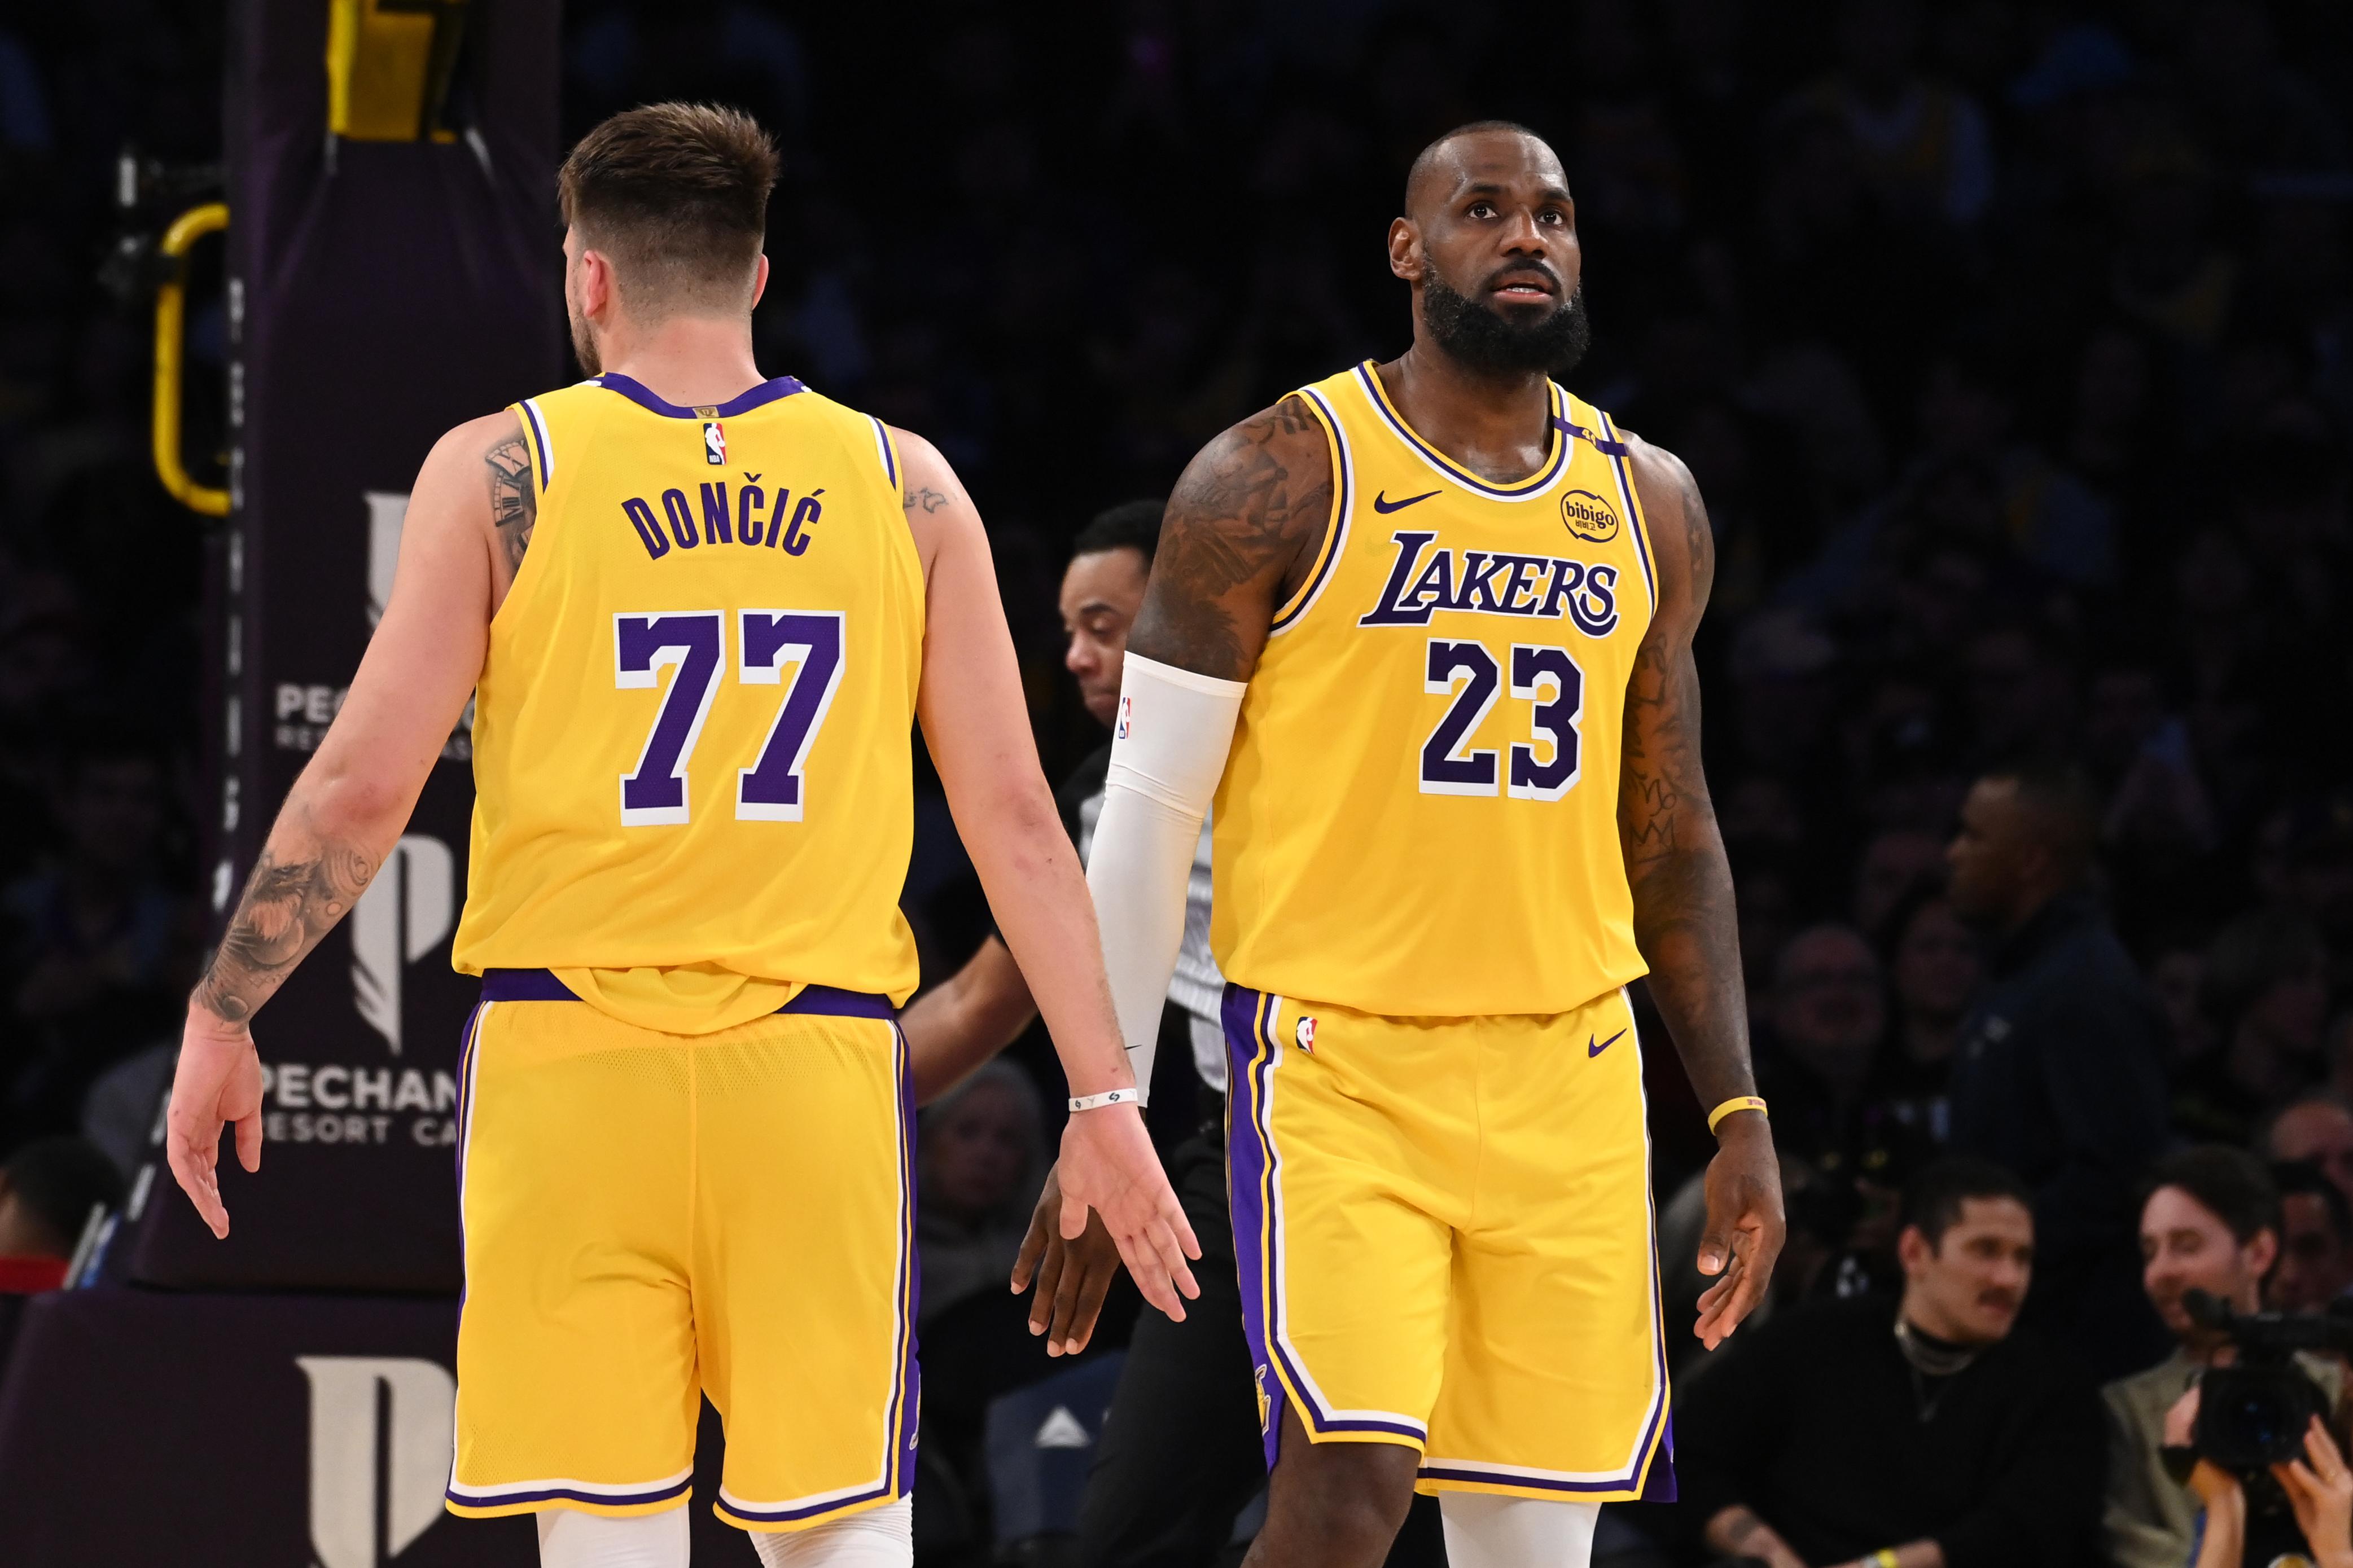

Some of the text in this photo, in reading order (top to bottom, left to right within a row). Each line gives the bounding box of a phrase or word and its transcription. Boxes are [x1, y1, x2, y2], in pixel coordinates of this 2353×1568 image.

[621, 472, 825, 560] DONČIĆ
[1566, 501, 1614, 529] bibigo
[1575, 519, 1597, 531] 비비고
[1356, 530, 1620, 639] LAKERS
[612, 608, 845, 827] 77
[1419, 637, 1585, 802] 23
[262, 1113, 391, 1144] ESORT
